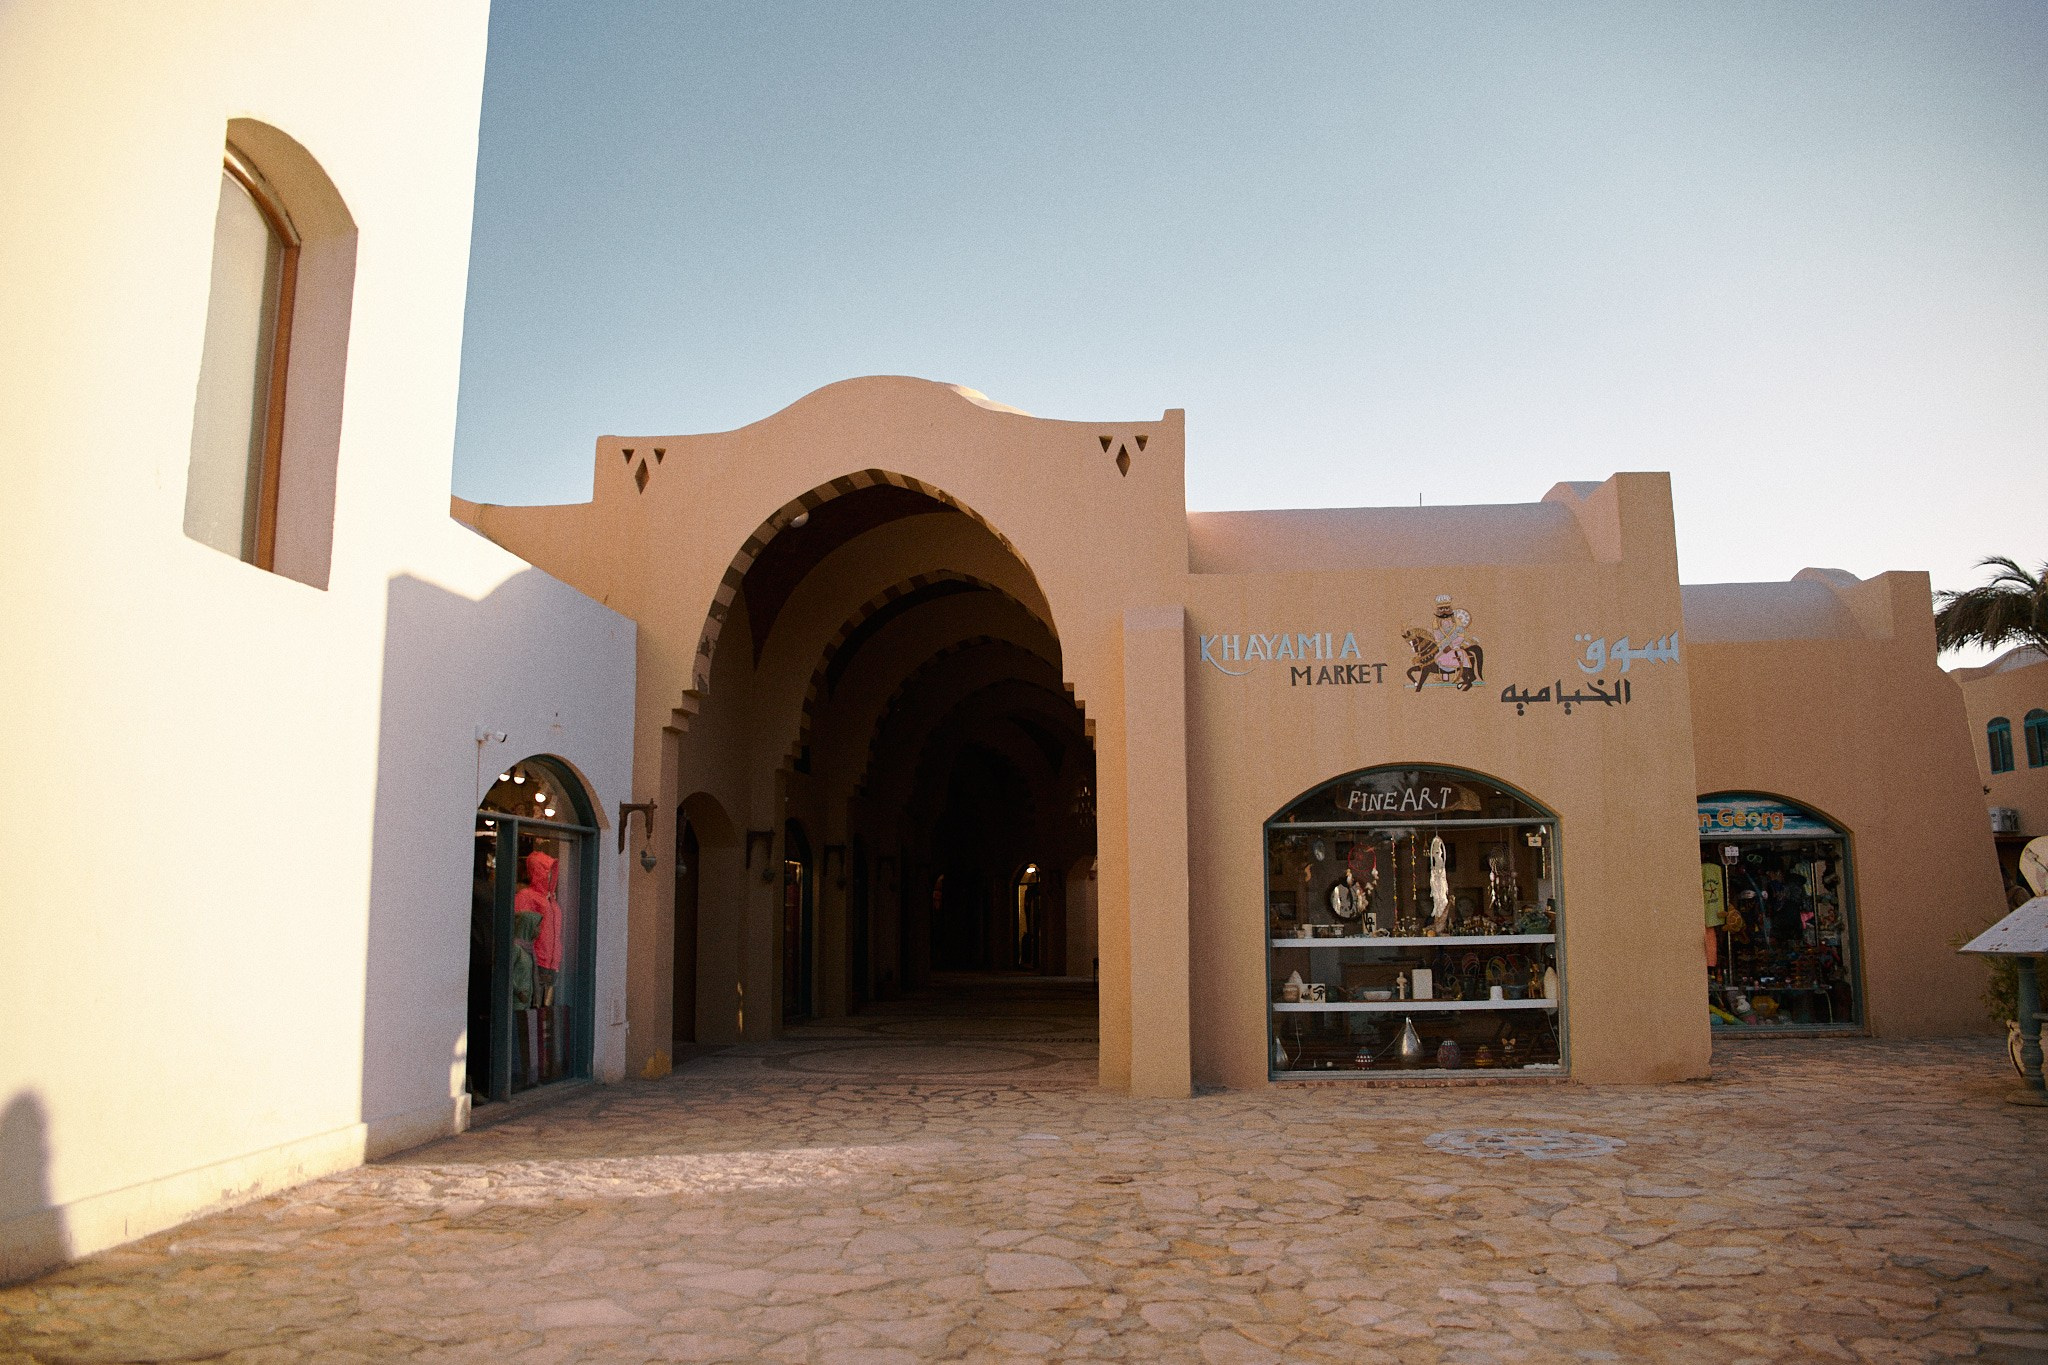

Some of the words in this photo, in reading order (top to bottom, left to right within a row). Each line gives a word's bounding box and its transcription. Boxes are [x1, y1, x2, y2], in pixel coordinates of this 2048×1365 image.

[1200, 631, 1362, 676] KHAYAMIA
[1574, 630, 1680, 674] سوق
[1290, 663, 1388, 686] MARKET
[1347, 790, 1398, 812] FINE
[1399, 786, 1452, 811] ART
[1717, 808, 1784, 831] Georg
